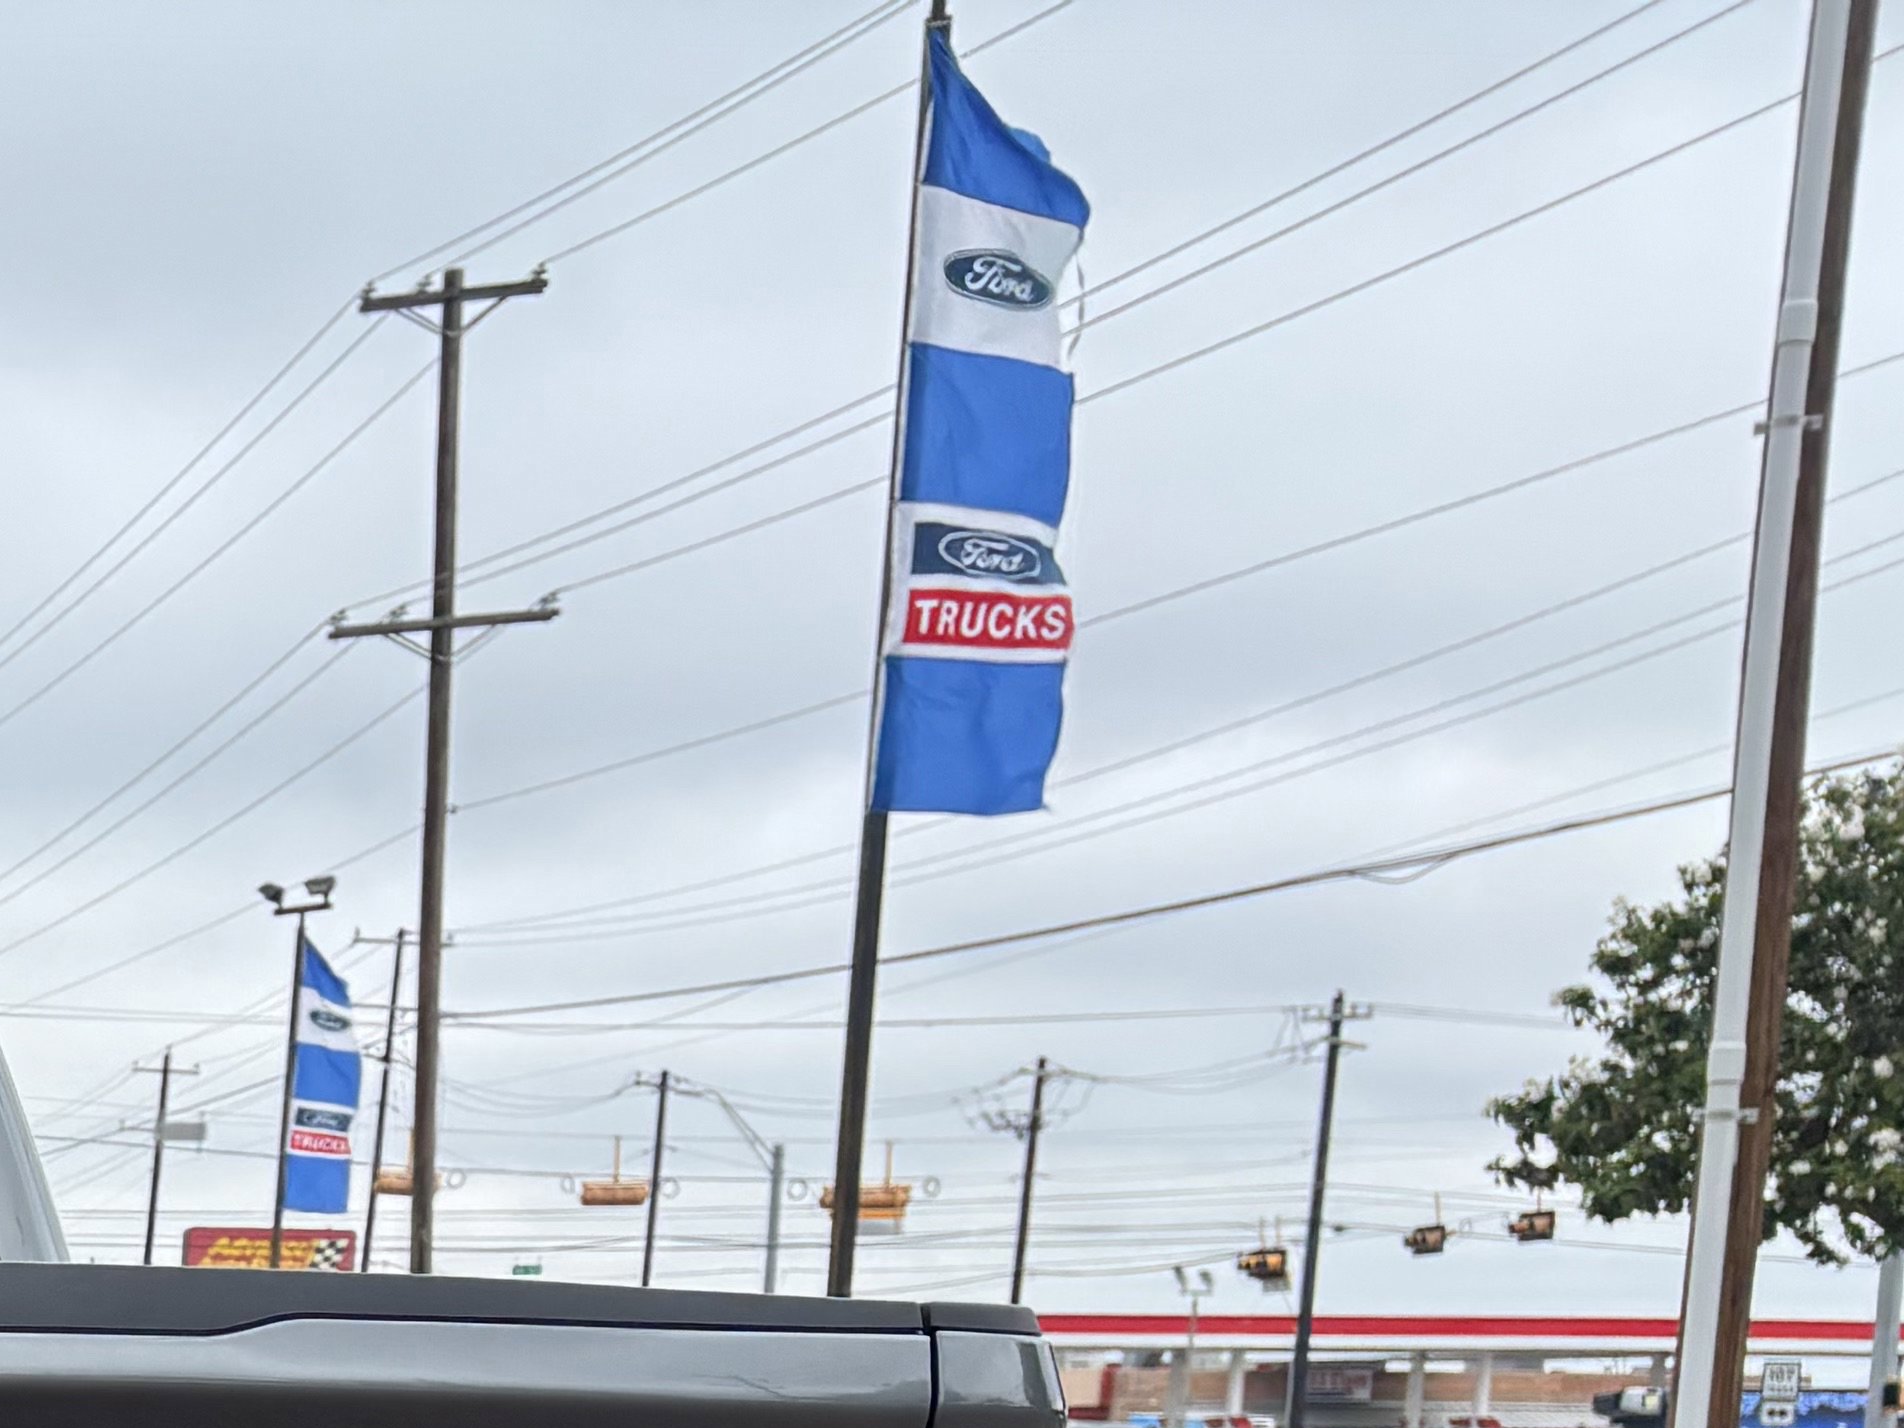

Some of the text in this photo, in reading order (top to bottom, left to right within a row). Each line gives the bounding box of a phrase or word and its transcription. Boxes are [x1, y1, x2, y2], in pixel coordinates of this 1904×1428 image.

[964, 255, 1034, 302] Ford
[960, 538, 1025, 573] Ford
[914, 599, 1067, 641] TRUCKS
